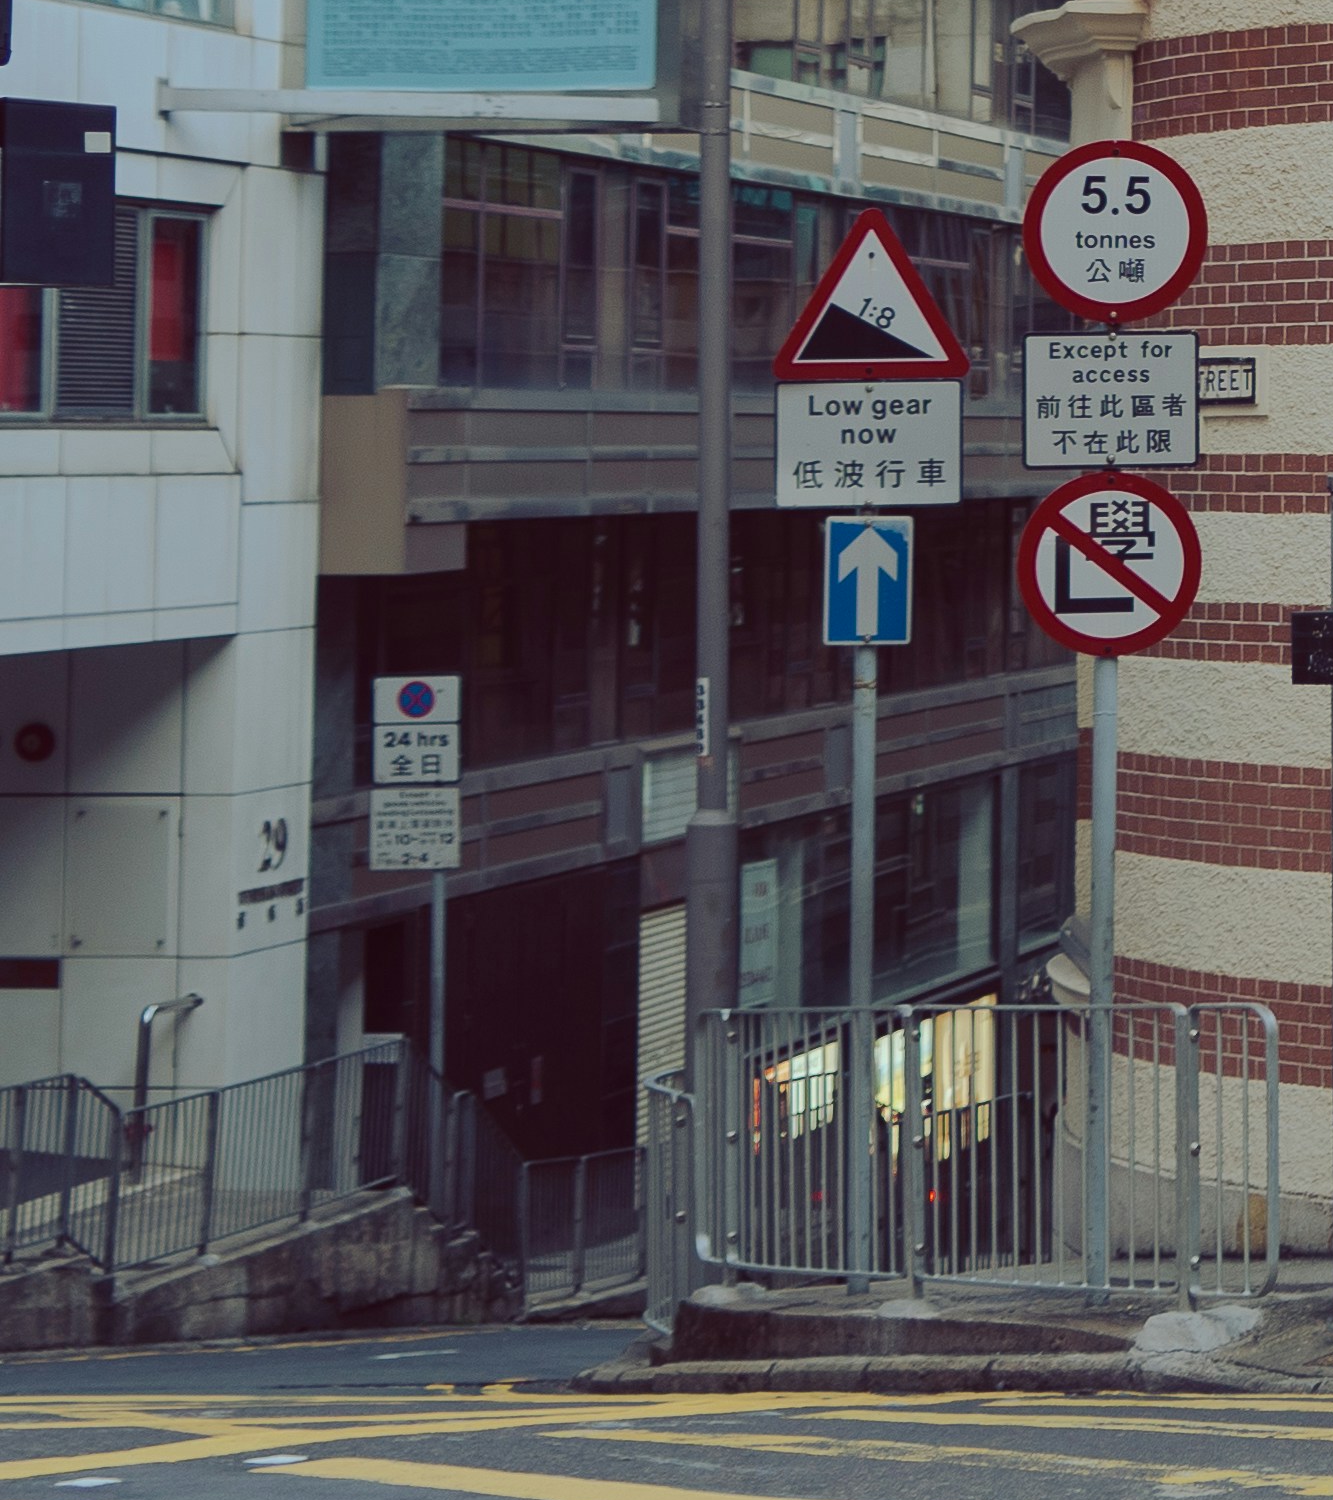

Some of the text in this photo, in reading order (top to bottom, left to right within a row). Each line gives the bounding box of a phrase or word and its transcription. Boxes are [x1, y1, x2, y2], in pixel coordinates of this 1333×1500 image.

[1081, 176, 1152, 216] 5.5
[1075, 231, 1156, 249] tonnes
[1086, 258, 1145, 283] 公噸
[857, 297, 896, 329] 1:8
[1049, 340, 1173, 361] Except for
[1072, 368, 1150, 383] access
[809, 395, 932, 421] Low gear
[1036, 393, 1187, 419] 前往此區者
[841, 428, 896, 444] now
[1051, 430, 1172, 455] 不在此限
[793, 458, 946, 488] 低波行車
[384, 731, 449, 748] 24 hrs
[390, 754, 442, 777] 全日
[258, 818, 287, 872] 29
